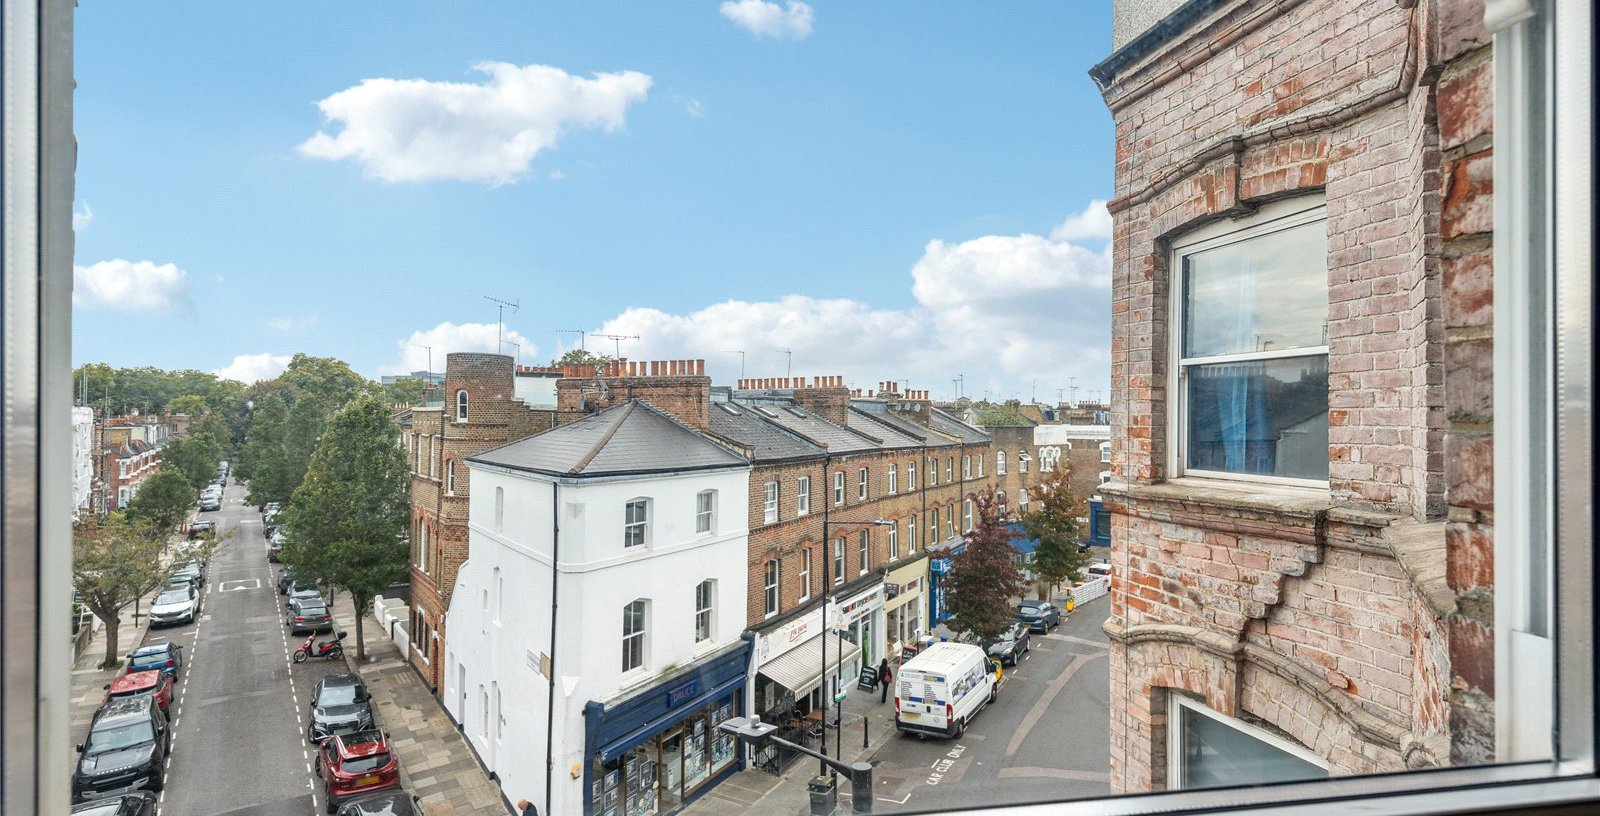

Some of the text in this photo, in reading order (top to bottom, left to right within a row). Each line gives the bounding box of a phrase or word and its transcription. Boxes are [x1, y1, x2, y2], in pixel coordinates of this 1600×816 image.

[926, 744, 967, 785] CAR CLUB ONLY
